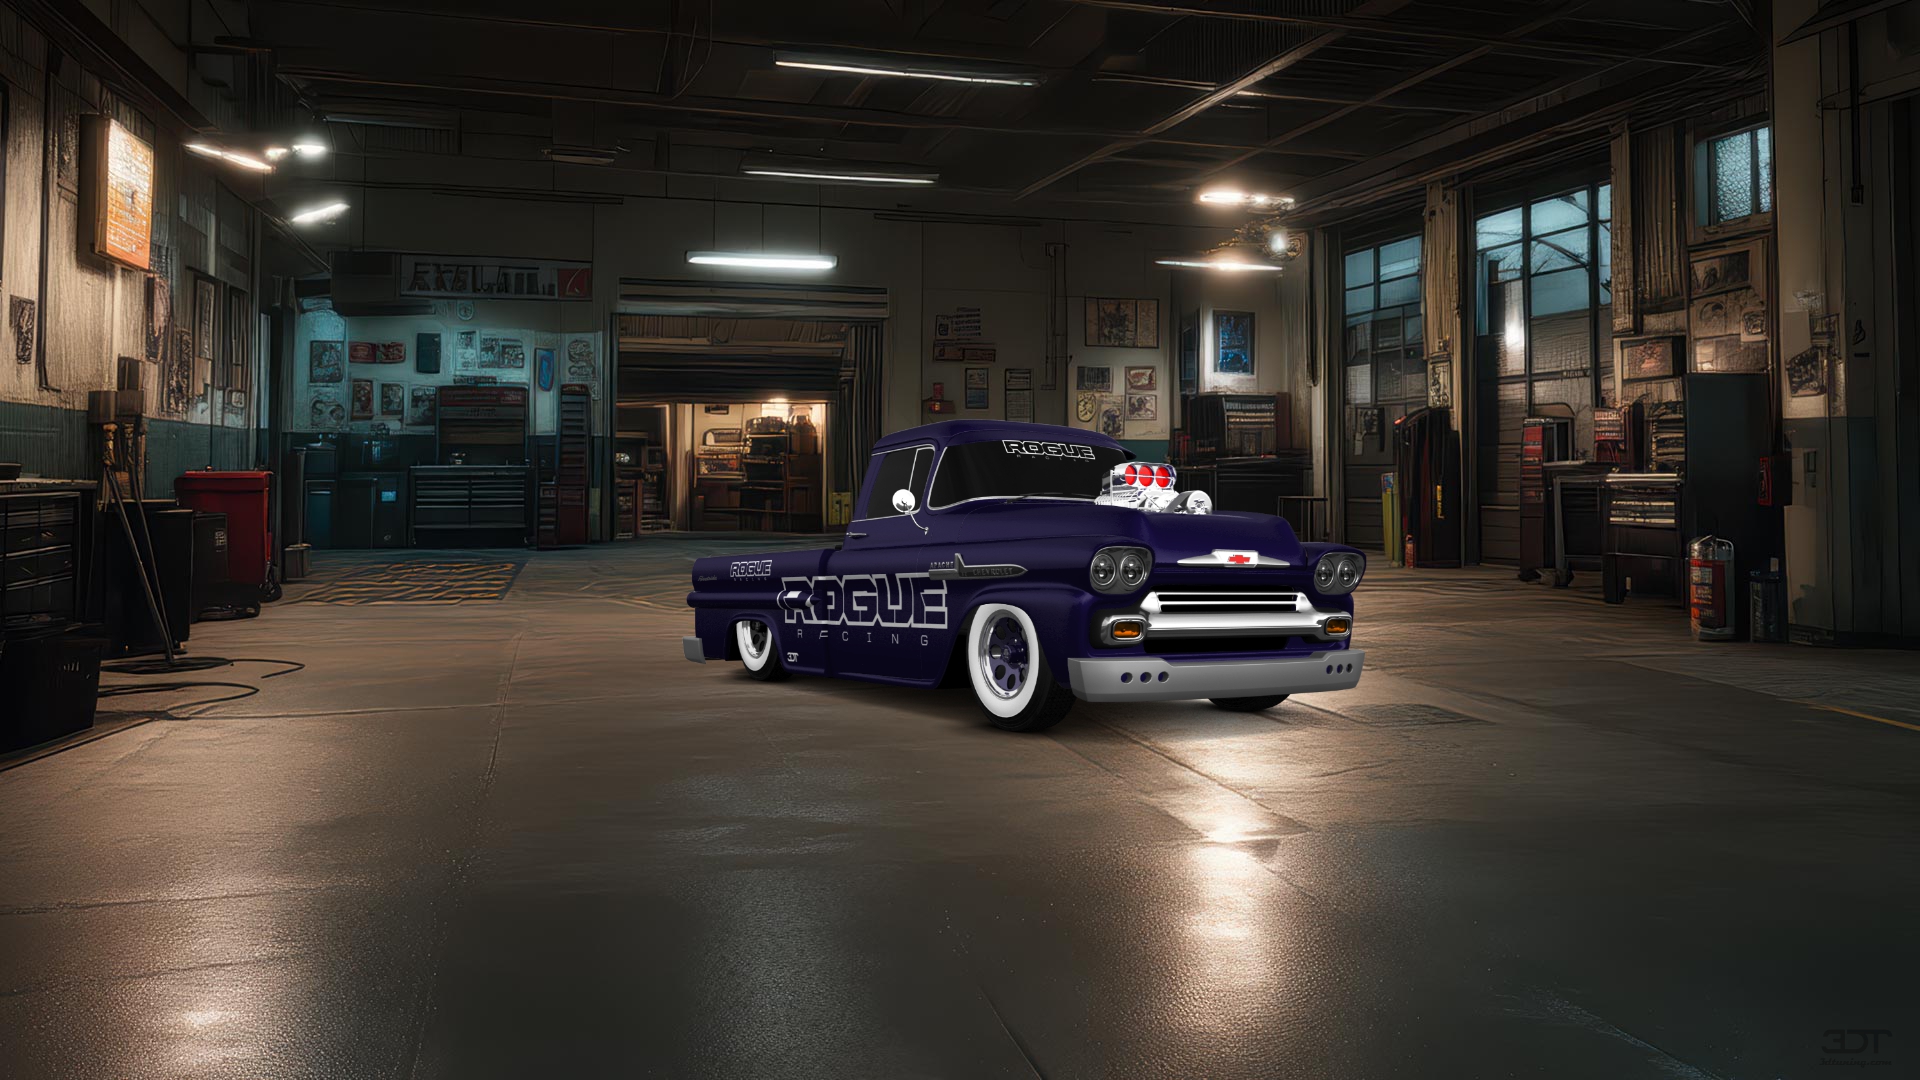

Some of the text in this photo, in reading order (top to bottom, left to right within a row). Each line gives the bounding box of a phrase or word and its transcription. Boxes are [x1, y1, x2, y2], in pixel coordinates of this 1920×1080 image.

[1002, 440, 1096, 460] ROGUE
[730, 560, 773, 578] ROGUE
[930, 561, 954, 569] APACHE
[972, 567, 1014, 576] CHEVROLET
[781, 573, 948, 629] ROGUE
[797, 629, 929, 646] RACING
